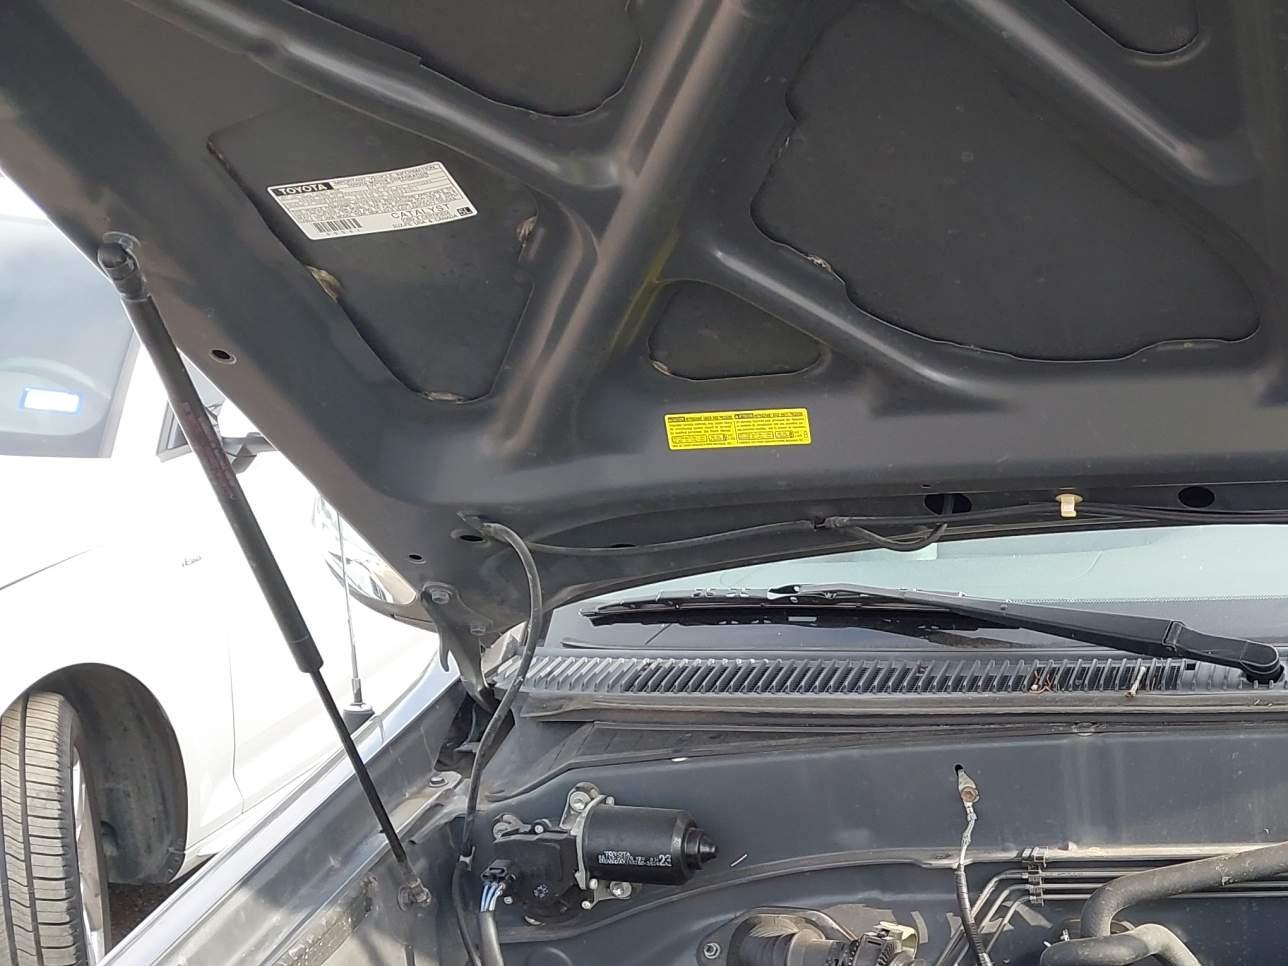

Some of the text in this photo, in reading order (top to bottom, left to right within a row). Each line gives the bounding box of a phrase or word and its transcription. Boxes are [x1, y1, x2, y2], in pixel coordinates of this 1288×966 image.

[281, 183, 328, 196] TOYOTA
[390, 203, 451, 220] CATALYST
[659, 854, 673, 867] 23
